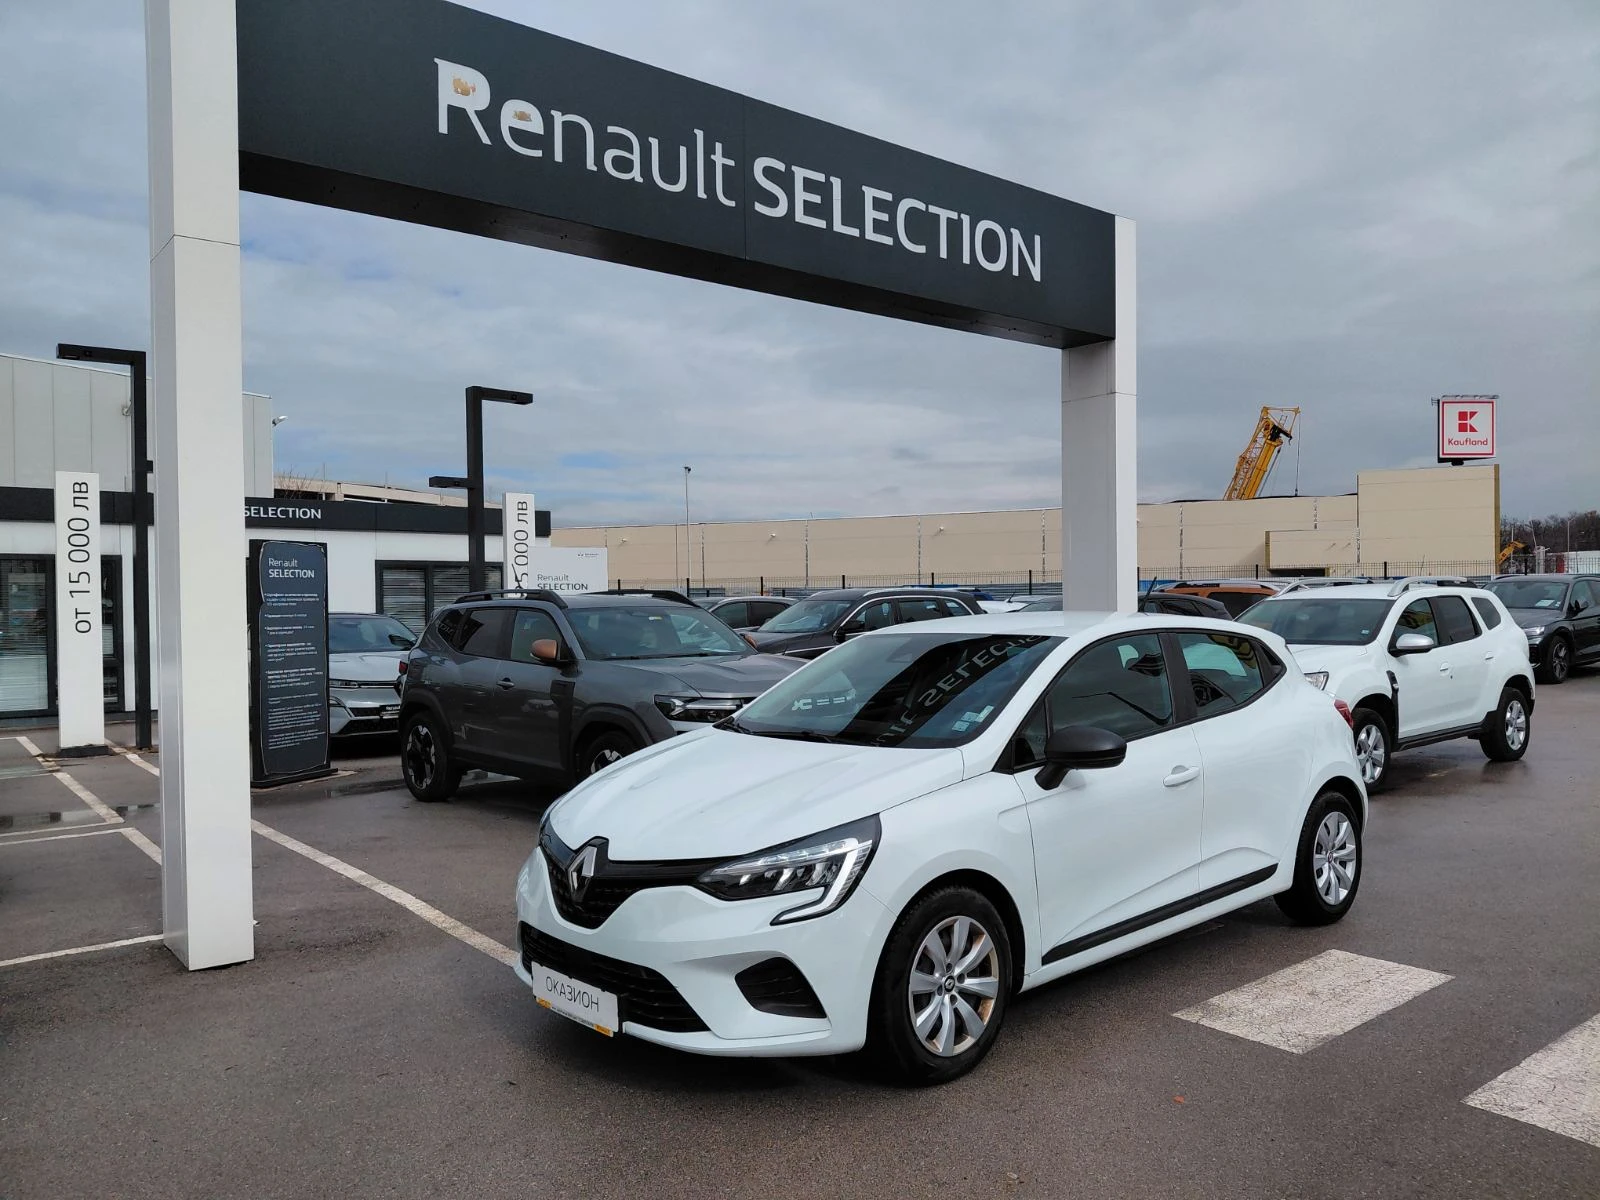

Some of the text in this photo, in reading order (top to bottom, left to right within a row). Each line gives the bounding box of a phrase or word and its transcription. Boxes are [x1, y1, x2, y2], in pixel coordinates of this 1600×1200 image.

[433, 57, 1042, 283] Renault SELECTION
[1447, 437, 1488, 446] Kaufland
[67, 517, 90, 563] 000
[514, 529, 528, 566] 000
[268, 557, 298, 568] Renault
[268, 569, 315, 578] SELECTION
[537, 573, 569, 582] Renault
[69, 571, 91, 598] 15
[537, 583, 588, 591] SELECTION
[545, 975, 600, 1013] ОКАЗИОН
